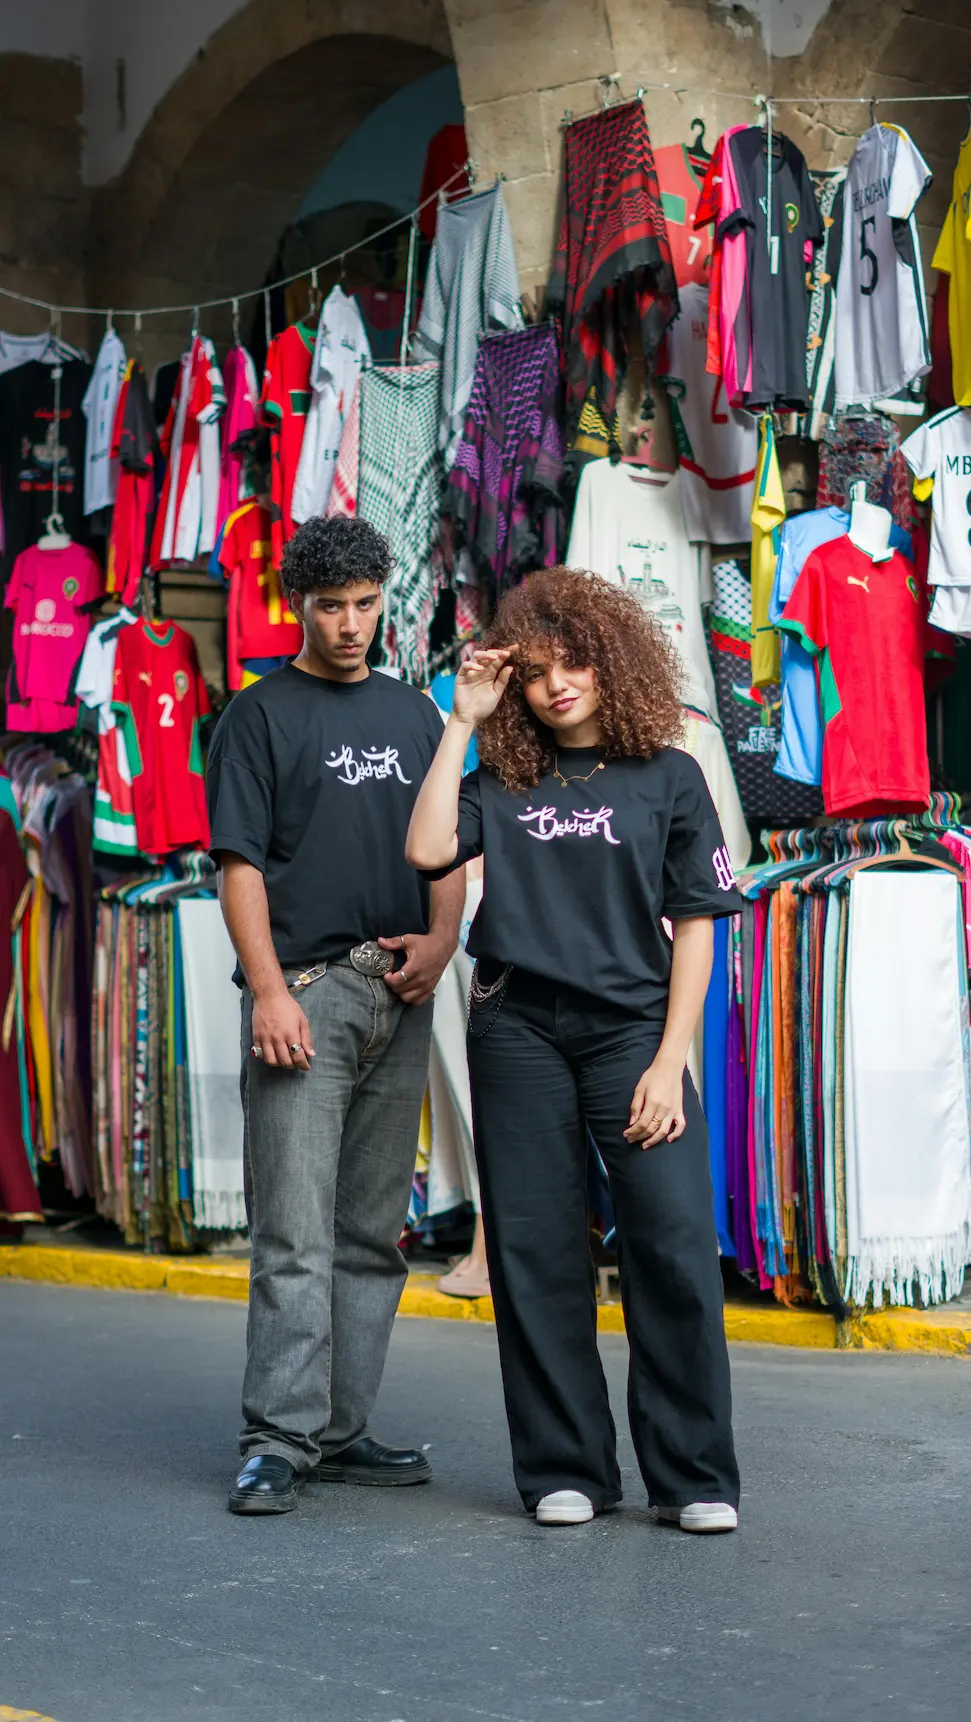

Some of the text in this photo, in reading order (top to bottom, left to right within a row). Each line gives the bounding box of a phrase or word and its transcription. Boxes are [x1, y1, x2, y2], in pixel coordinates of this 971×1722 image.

[686, 235, 702, 266] 7
[860, 215, 879, 297] 5
[157, 692, 175, 728] 2
